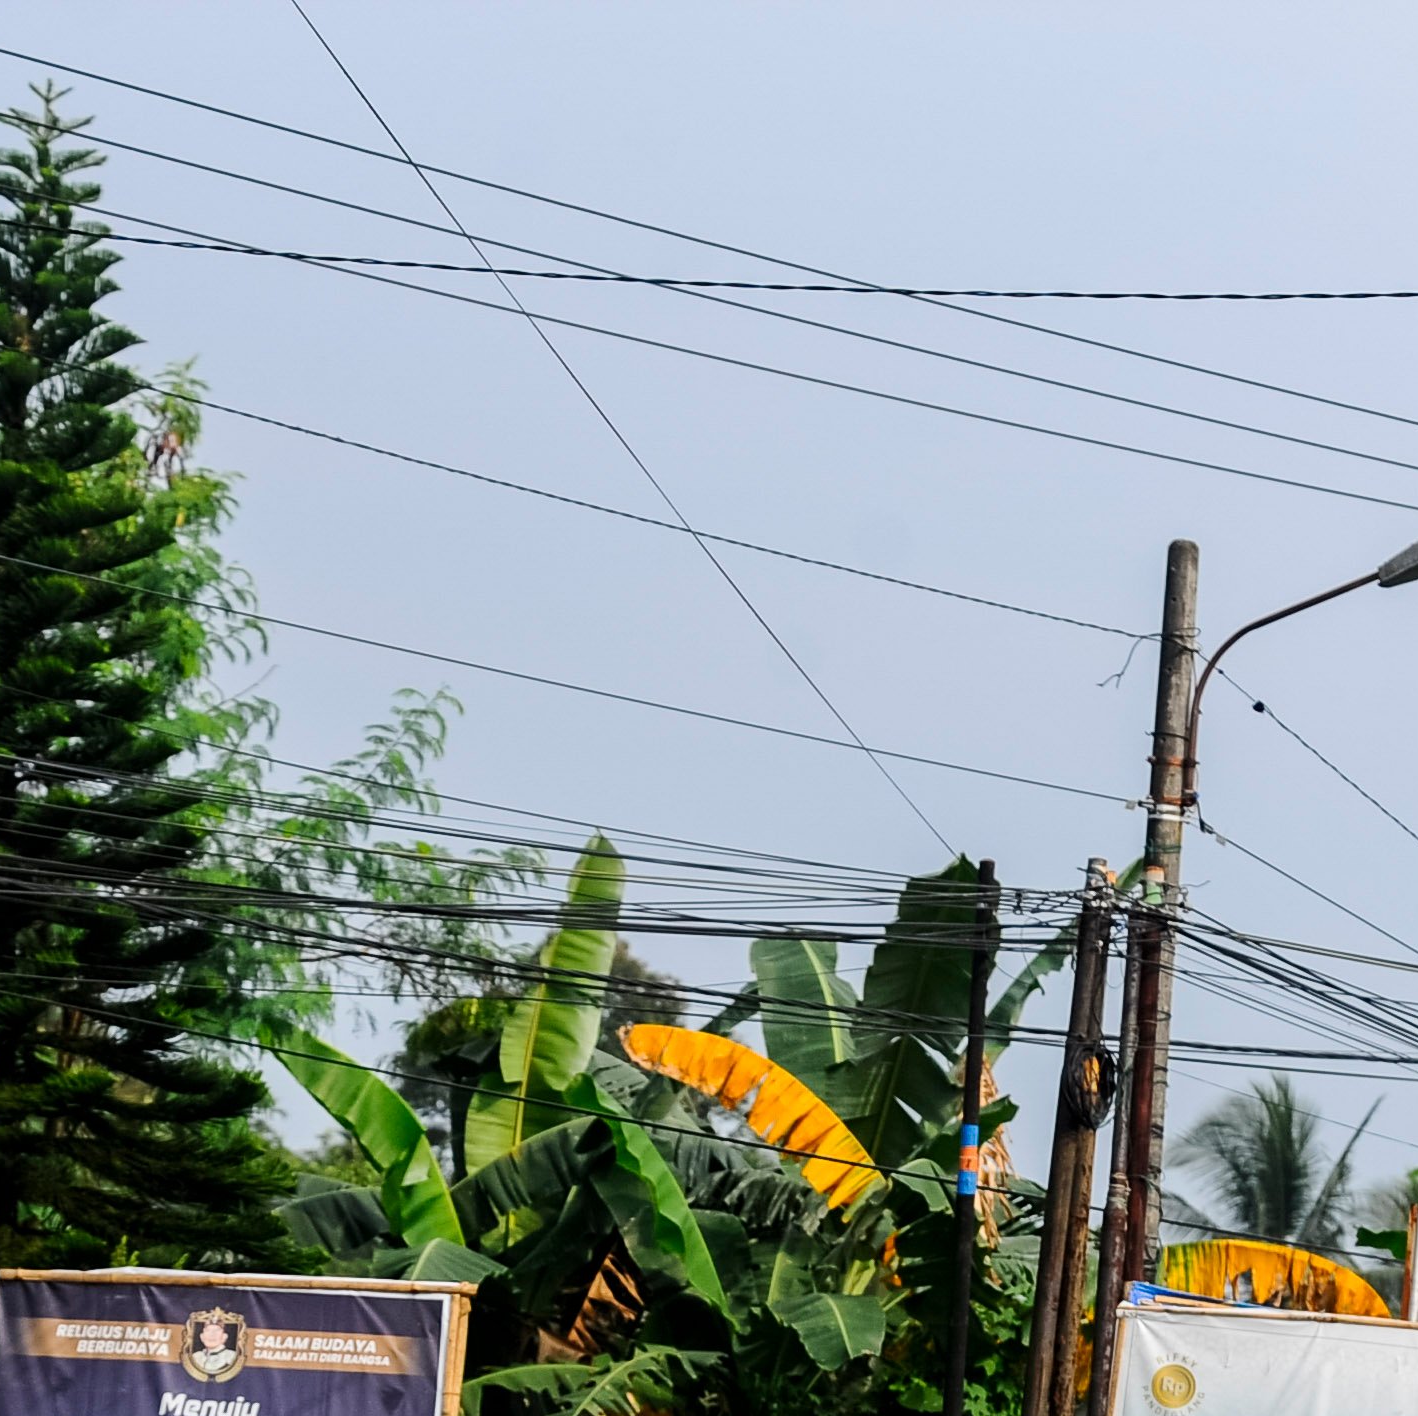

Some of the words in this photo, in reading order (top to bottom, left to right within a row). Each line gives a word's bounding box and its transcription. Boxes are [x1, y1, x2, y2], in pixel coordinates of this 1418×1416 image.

[55, 1323, 122, 1339] RELIGIUS
[124, 1326, 173, 1343] MAJU
[76, 1339, 170, 1357] BERBUDAYA
[253, 1333, 309, 1352] SALAM
[311, 1337, 377, 1354] BUDAYA
[252, 1348, 292, 1362] SALAM
[293, 1352, 318, 1363] JATI
[319, 1353, 342, 1365] DIRI
[343, 1354, 391, 1367] BANGSA
